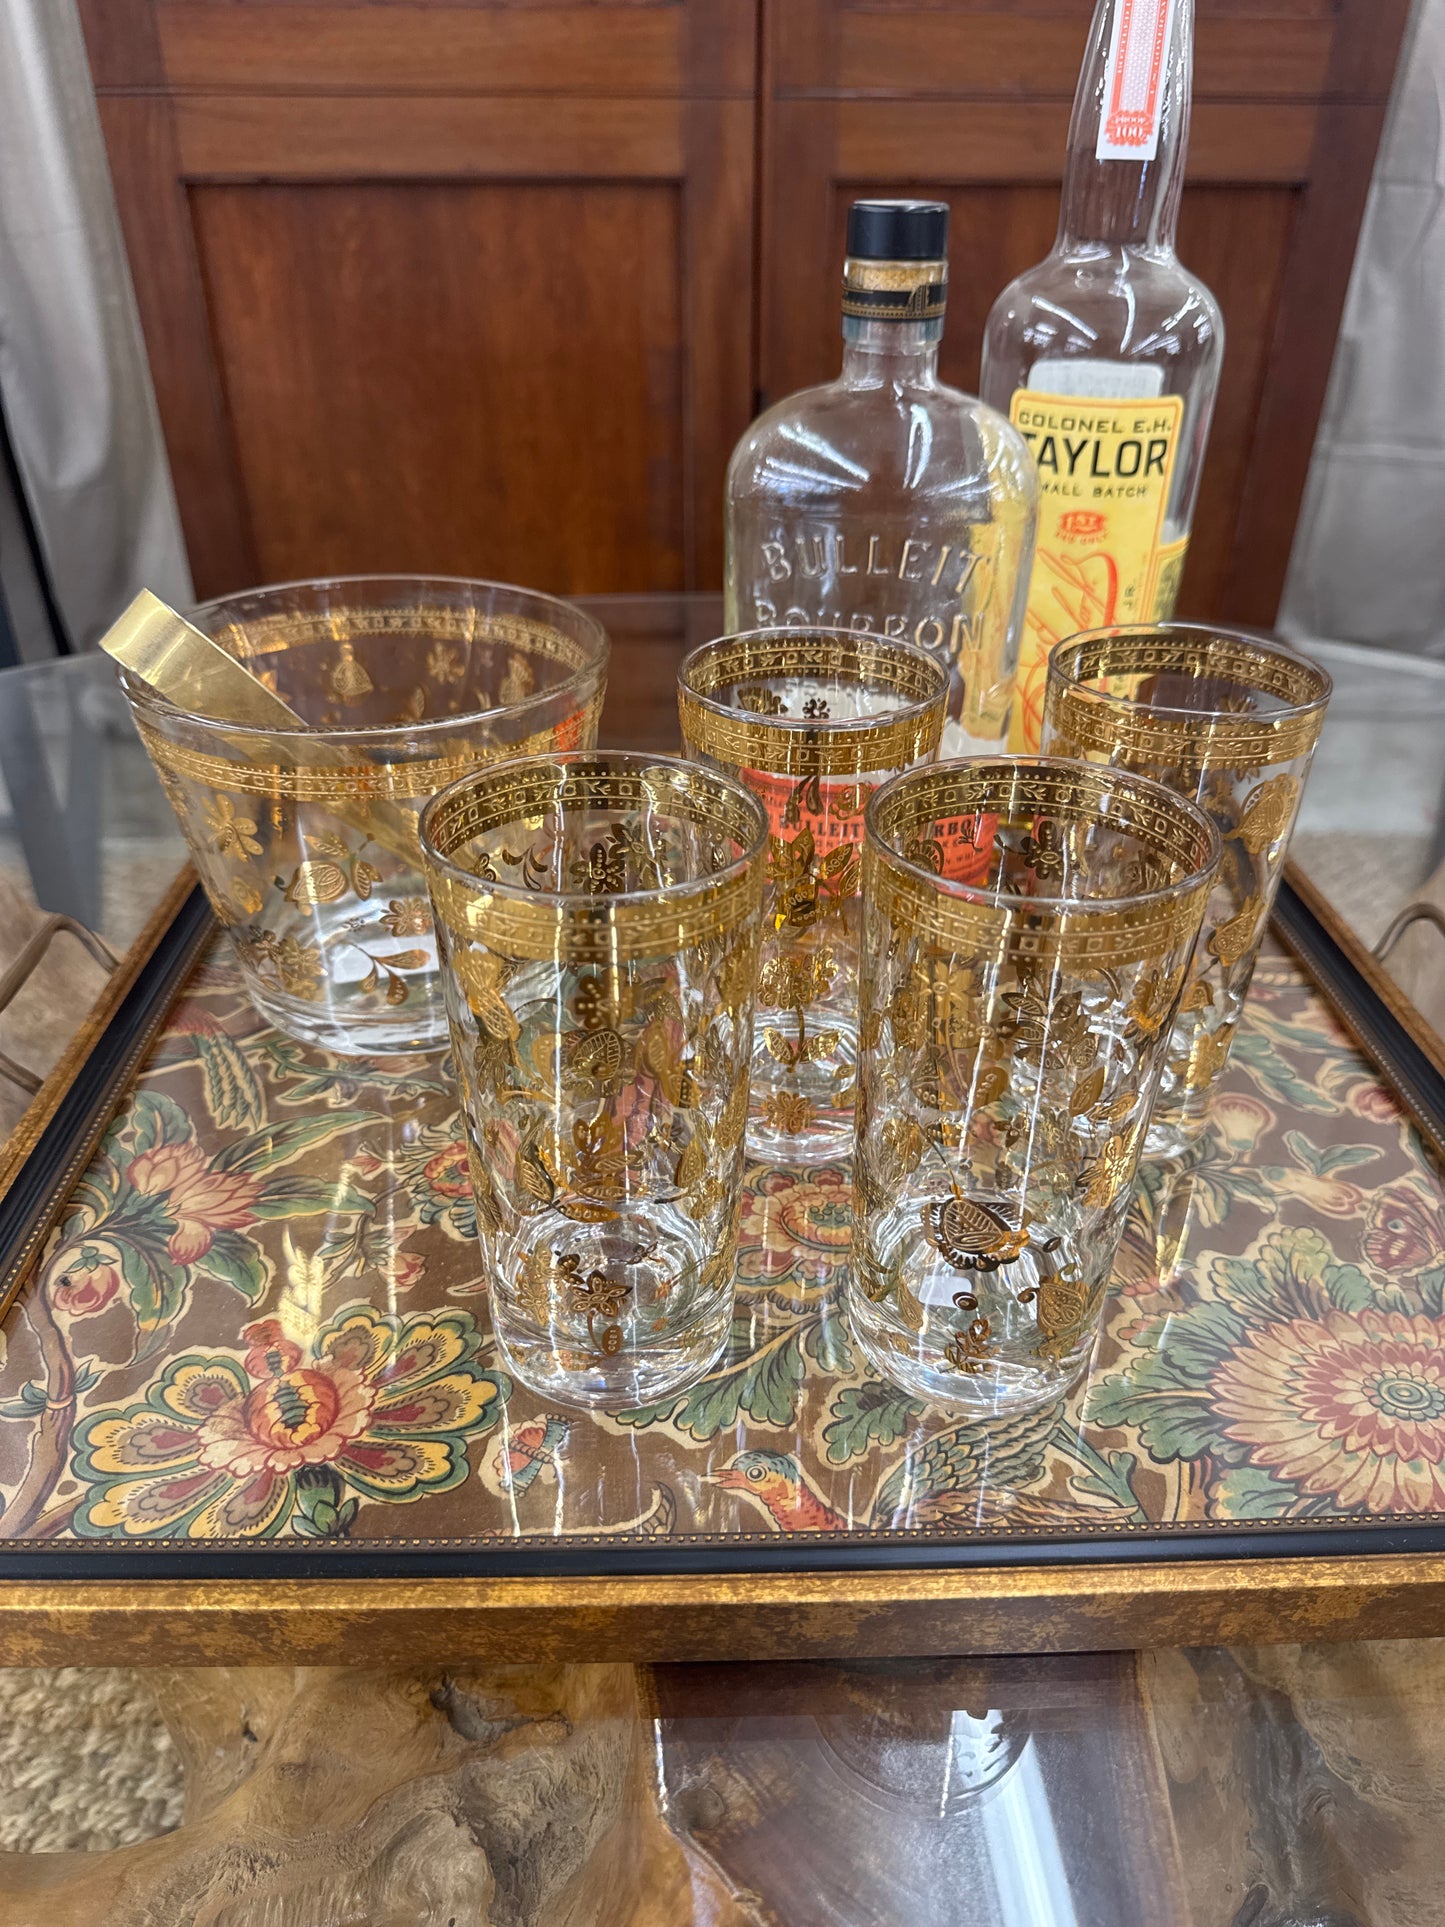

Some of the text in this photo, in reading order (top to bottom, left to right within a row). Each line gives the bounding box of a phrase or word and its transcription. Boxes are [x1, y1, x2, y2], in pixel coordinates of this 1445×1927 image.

[1116, 126, 1144, 138] 100
[1018, 411, 1122, 433] COLONEL
[1042, 482, 1148, 498] ALL BATCH
[761, 534, 991, 593] BULLEIT
